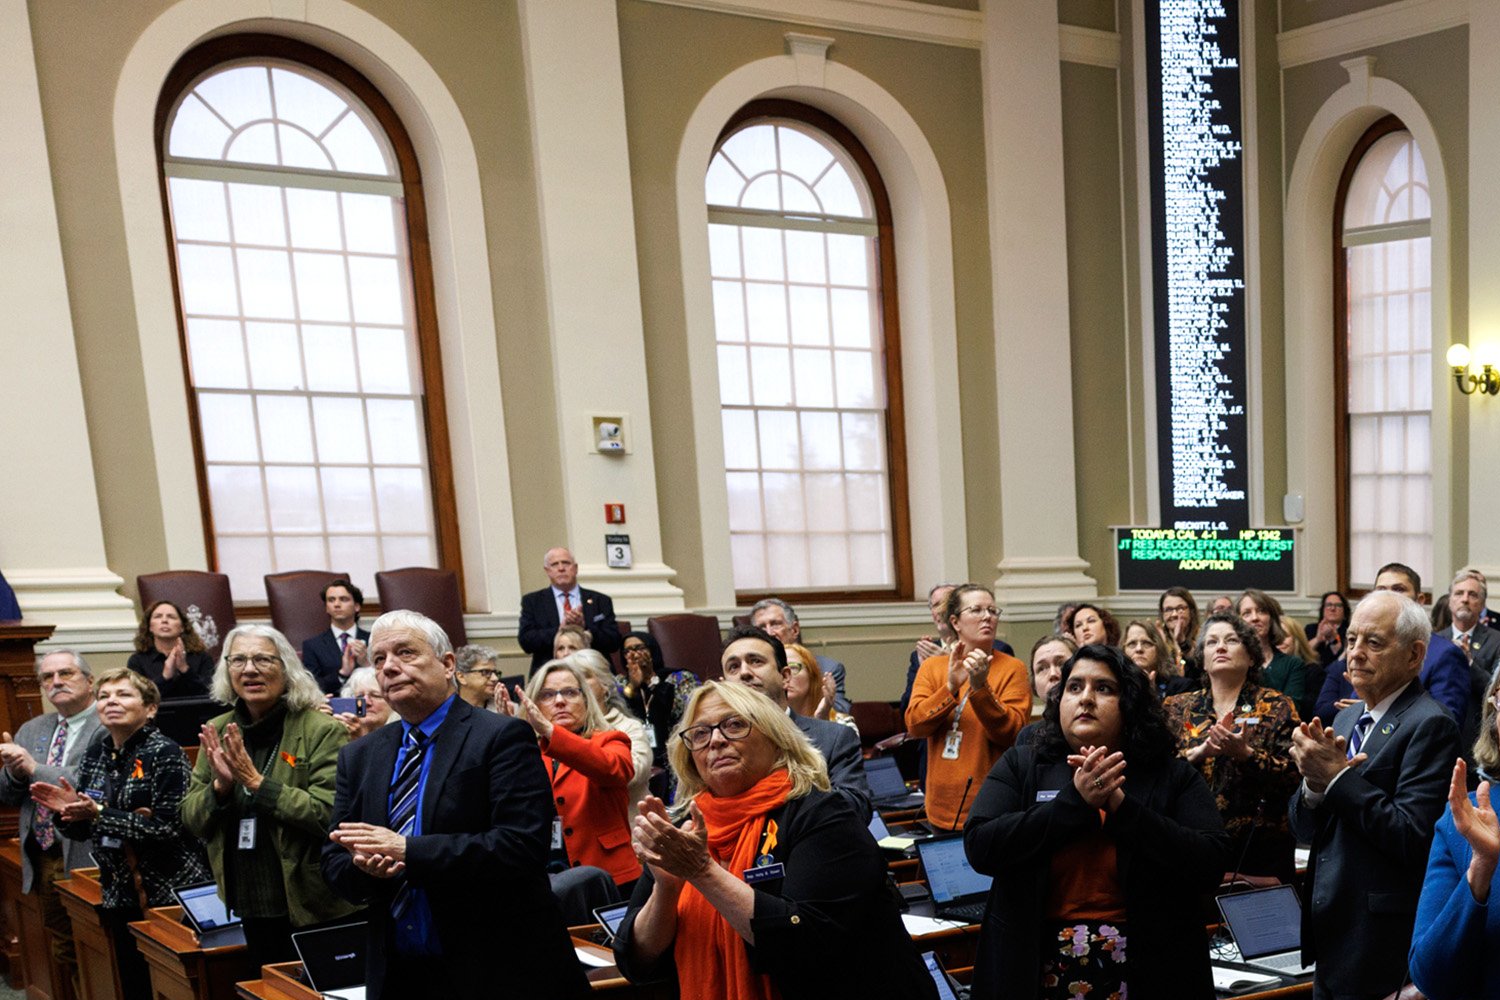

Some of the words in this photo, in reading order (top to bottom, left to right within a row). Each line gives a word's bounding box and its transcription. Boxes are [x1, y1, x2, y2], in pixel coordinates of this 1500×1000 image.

[1131, 530, 1175, 540] TODAY'S
[1177, 531, 1198, 540] CAL
[1201, 531, 1217, 539] 4-1
[1239, 531, 1254, 540] HP
[1258, 531, 1280, 540] 1342
[1119, 540, 1131, 549] JT
[1133, 540, 1155, 549] RES
[1157, 540, 1194, 550] RECOG
[1196, 540, 1244, 550] EFFORTS
[1246, 540, 1261, 550] OF
[1263, 540, 1294, 550] FIRST
[615, 547, 624, 560] 3
[1132, 550, 1203, 560] RESPONDERS
[1205, 550, 1216, 559] IN
[1218, 550, 1240, 560] THE
[1242, 550, 1281, 560] TRAGIC
[1179, 560, 1233, 570] ADOPTION
